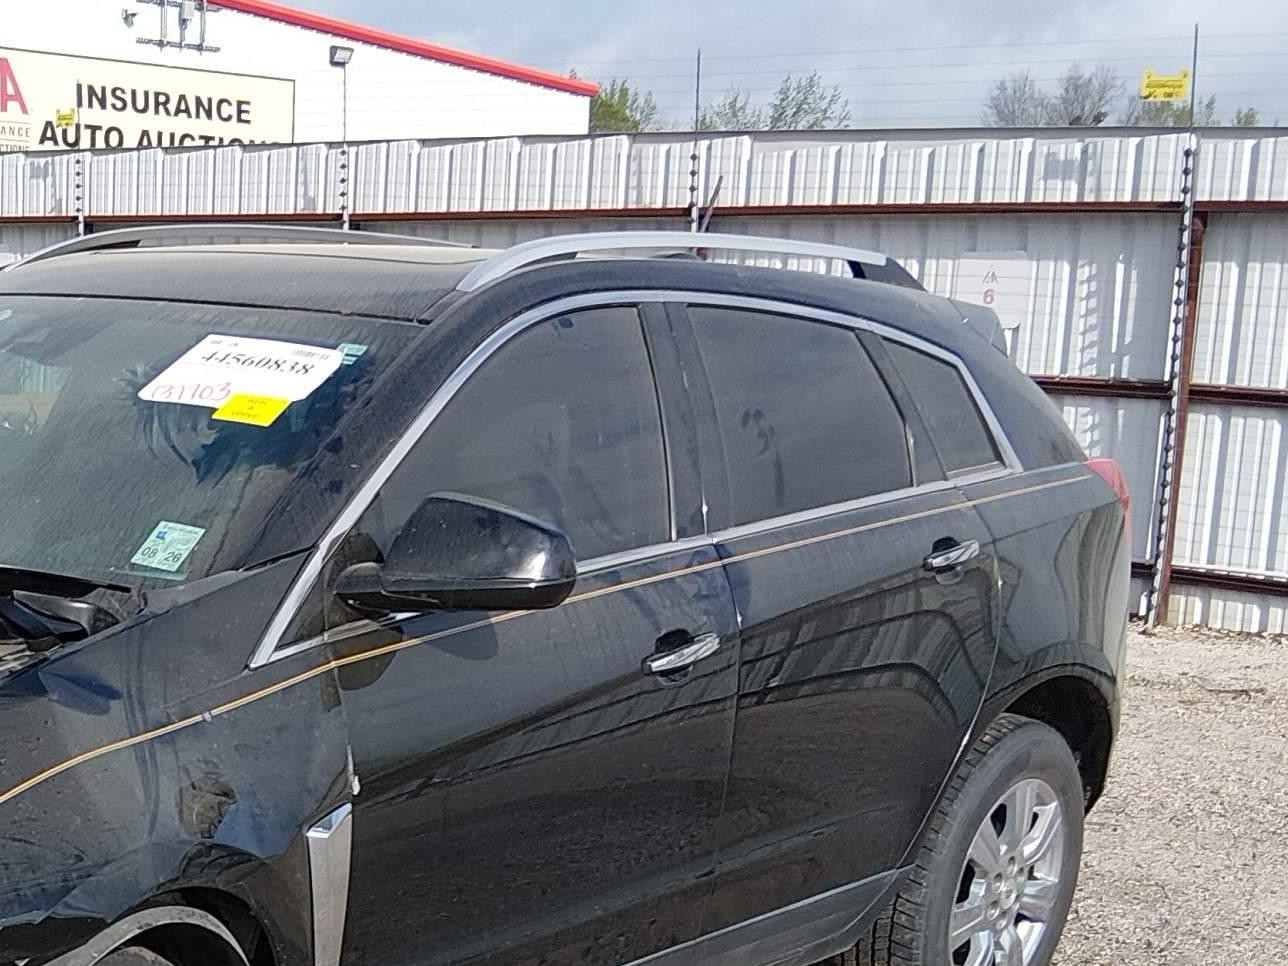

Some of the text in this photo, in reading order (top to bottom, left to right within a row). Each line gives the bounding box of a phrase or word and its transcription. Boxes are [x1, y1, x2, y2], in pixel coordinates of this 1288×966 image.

[76, 83, 252, 124] INSURANCE
[38, 120, 125, 148] AUTO
[983, 288, 995, 305] 6
[201, 350, 315, 375] 44560838
[140, 546, 183, 563] 08 26
